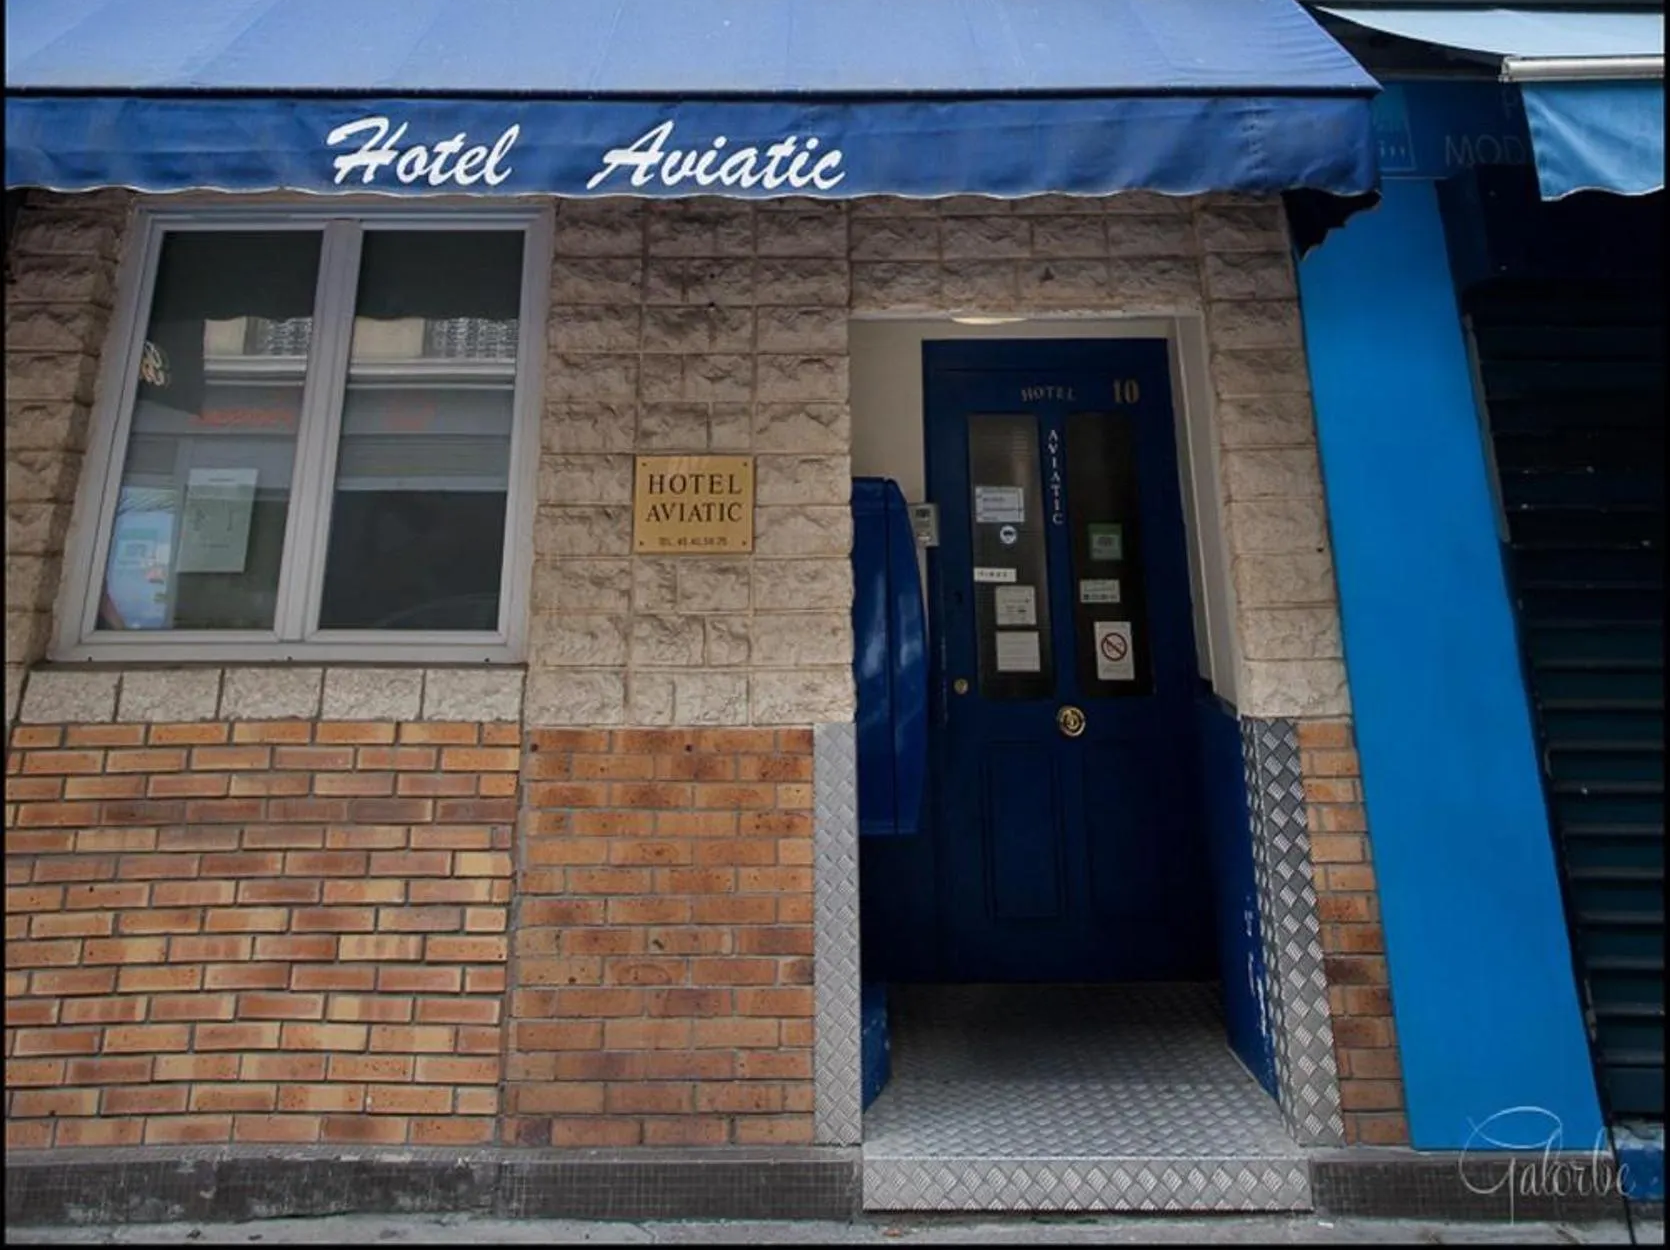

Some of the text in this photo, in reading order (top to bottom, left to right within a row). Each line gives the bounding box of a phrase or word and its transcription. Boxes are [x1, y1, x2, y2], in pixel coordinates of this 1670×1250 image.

[326, 116, 847, 191] Hotel Aviatic
[1021, 384, 1077, 402] HOTEL
[1113, 378, 1141, 405] 10
[648, 473, 743, 495] HOTEL
[1047, 429, 1064, 526] AVIATIC
[645, 501, 743, 523] AVIATIC
